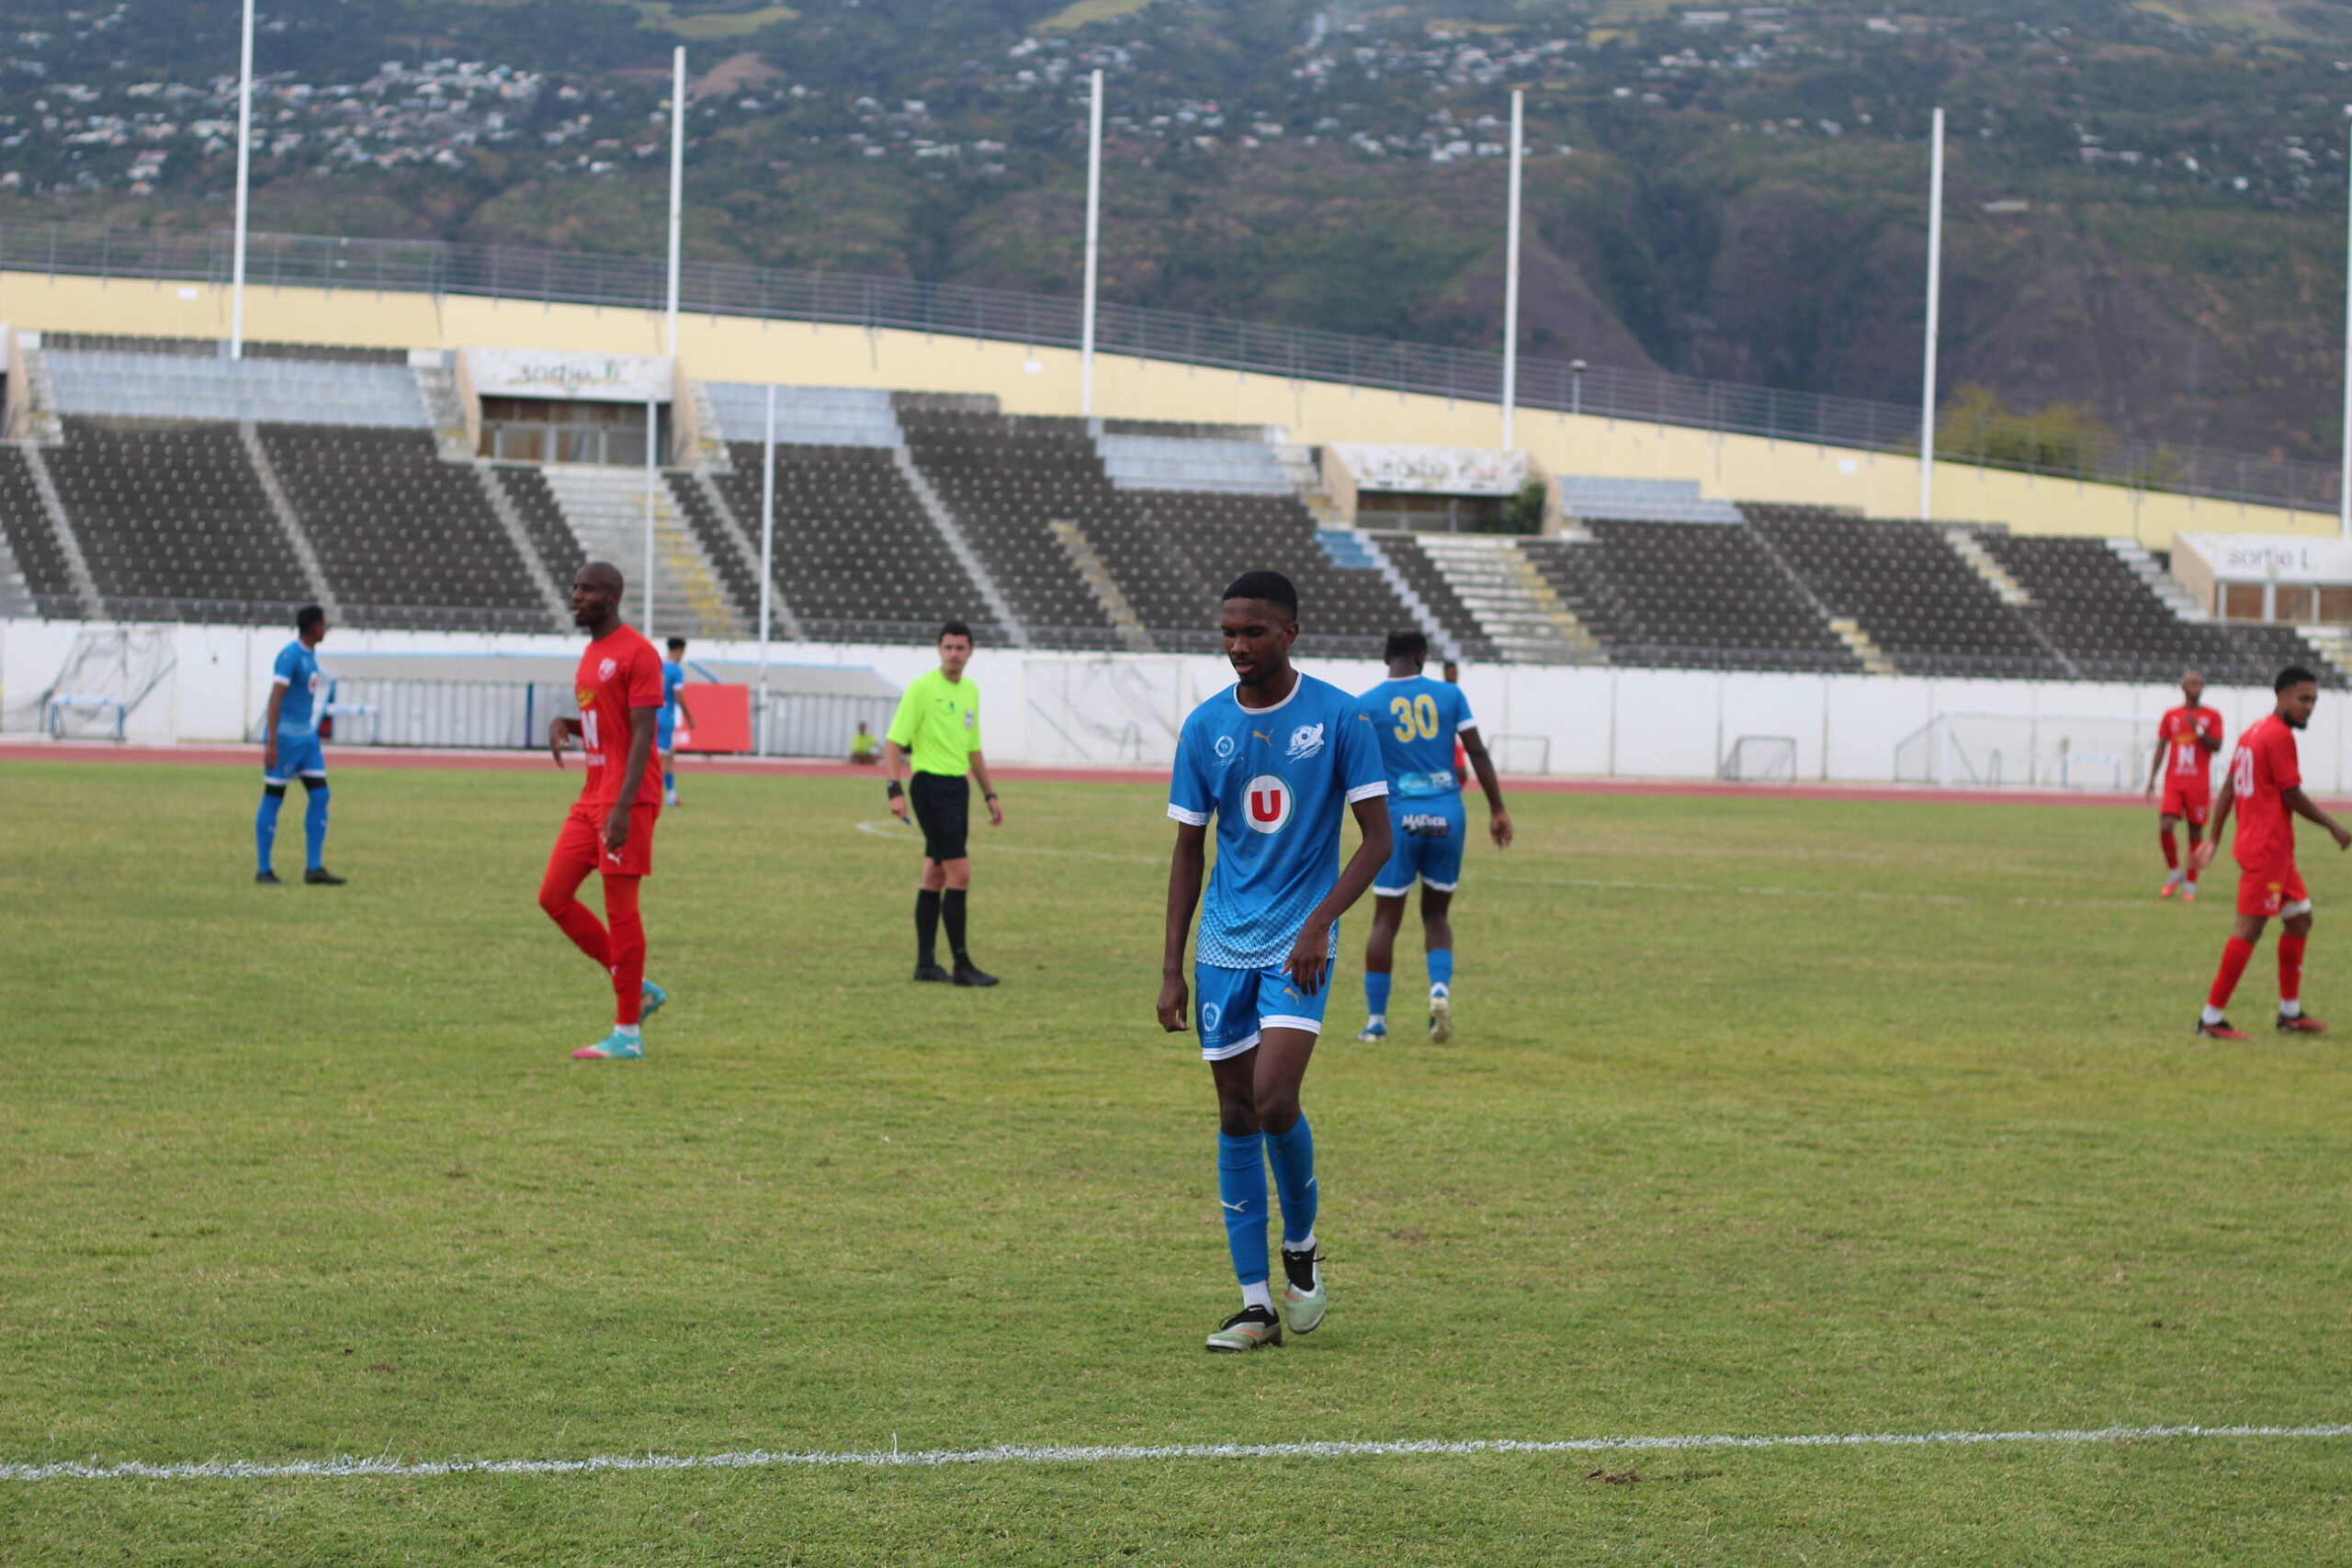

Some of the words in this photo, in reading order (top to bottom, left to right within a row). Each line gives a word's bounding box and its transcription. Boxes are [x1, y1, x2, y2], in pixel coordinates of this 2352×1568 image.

[581, 709, 599, 749] N
[1390, 694, 1439, 742] 30
[2177, 744, 2195, 766] N
[2233, 746, 2255, 797] 20
[1250, 789, 1282, 822] U
